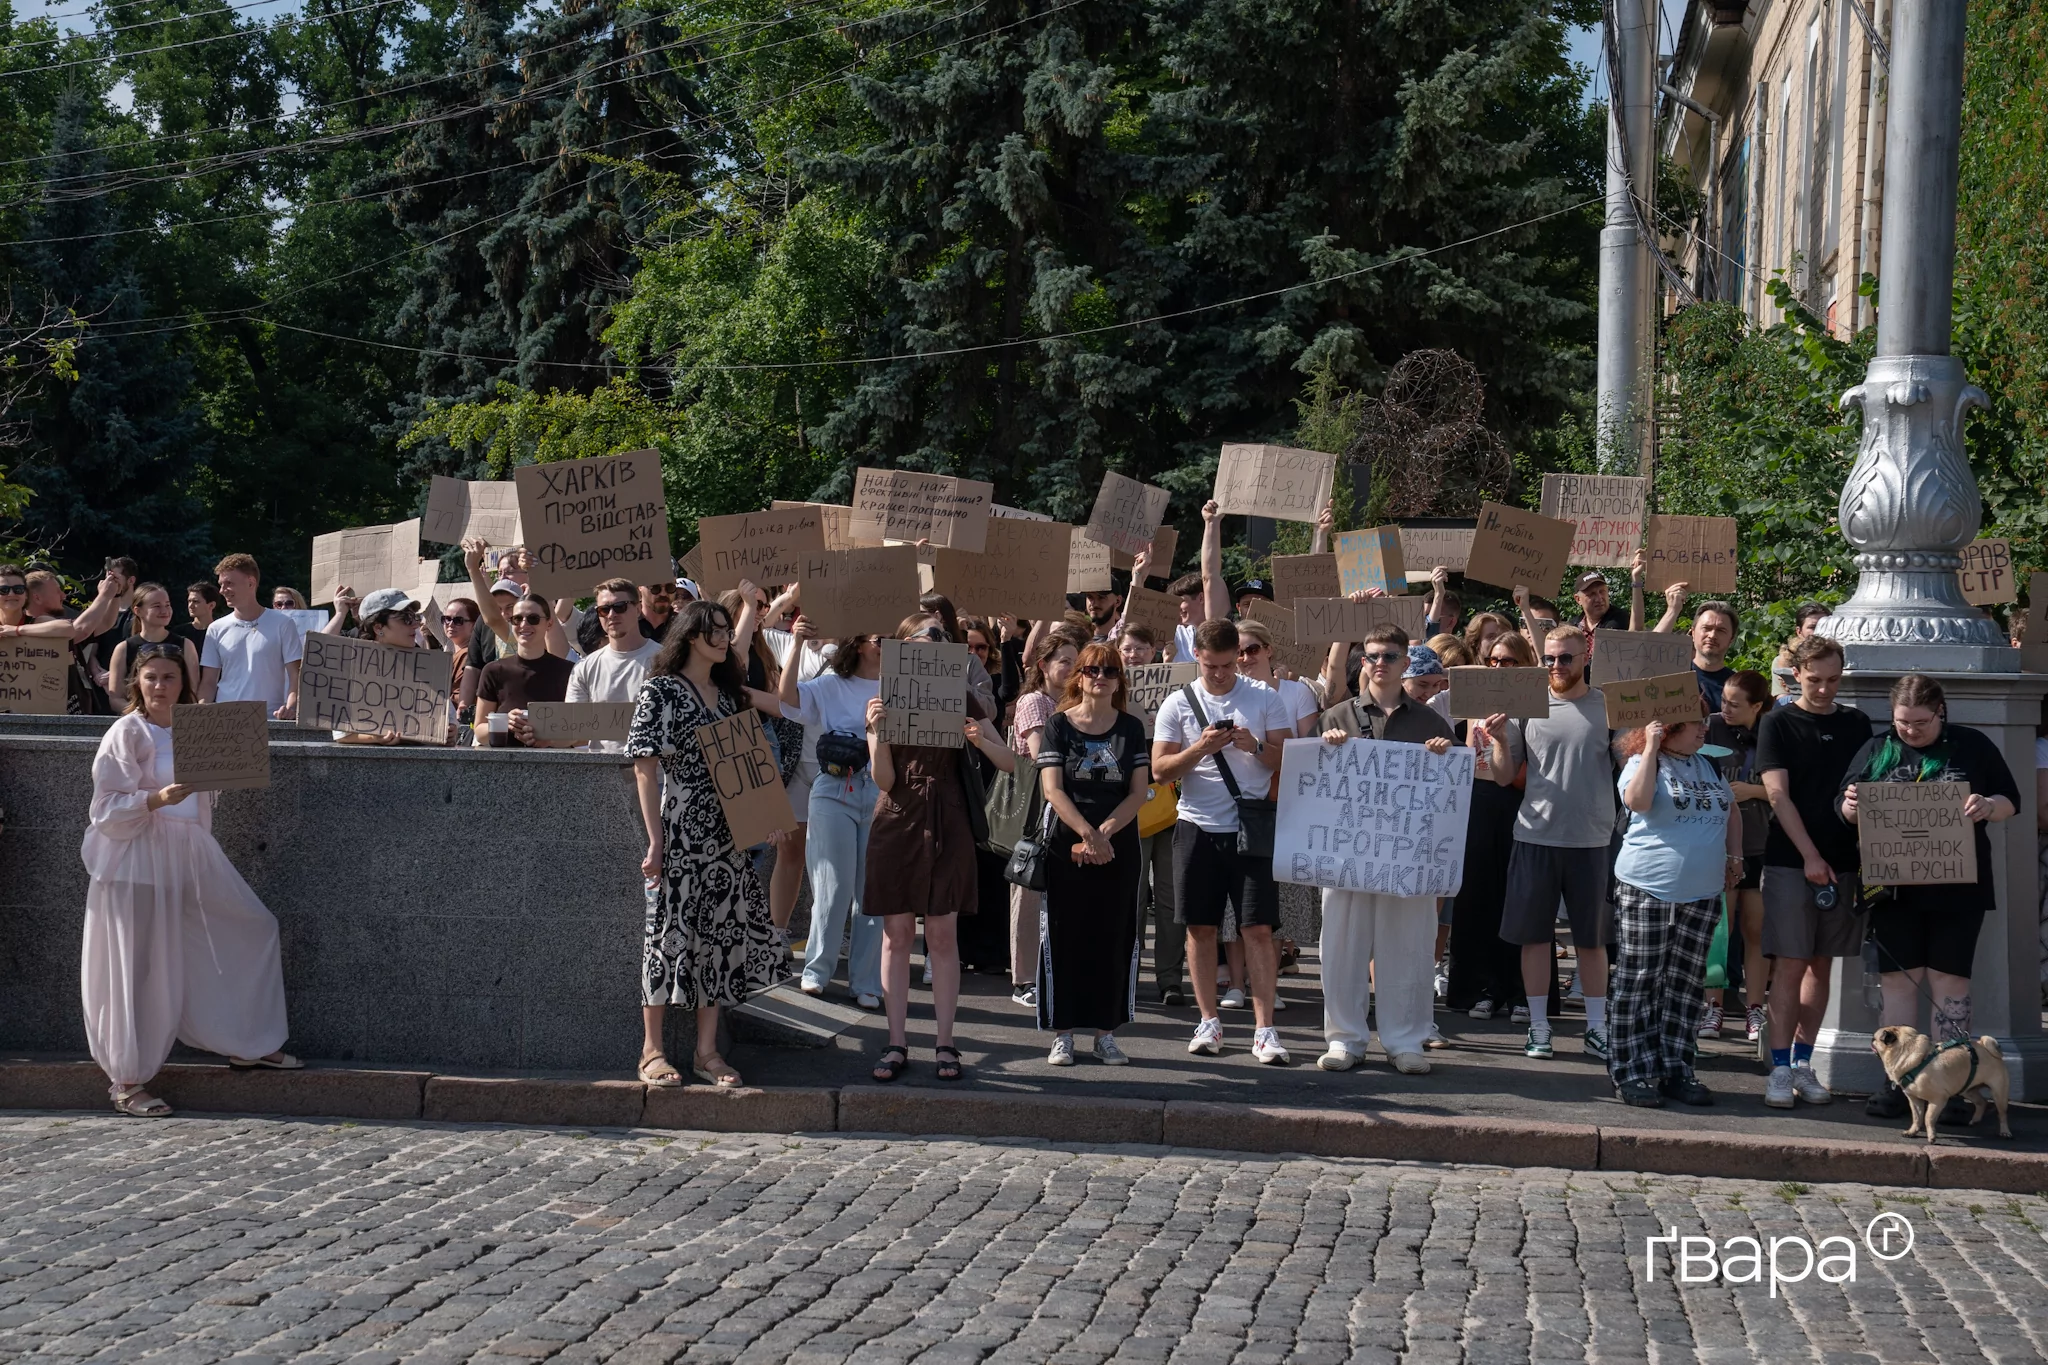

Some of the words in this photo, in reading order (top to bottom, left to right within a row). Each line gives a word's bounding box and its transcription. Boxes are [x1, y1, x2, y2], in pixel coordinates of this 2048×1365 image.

[536, 460, 636, 500] ХАРКІВ
[1115, 479, 1160, 509] РУКИ
[1557, 477, 1644, 498] ЗВІЛЬНЕННЯ
[1113, 498, 1145, 520] ГЕТЬ
[1557, 497, 1641, 515] ФЕДОРОВА
[1127, 521, 1157, 540] НАБУ
[1484, 511, 1502, 532] Не
[1500, 523, 1534, 541] робіть
[1559, 518, 1642, 536] ОДАРУНОК
[1500, 540, 1544, 565] послугу
[1305, 603, 1345, 636] МИ
[15, 641, 60, 658] РІШЕНЬ
[899, 642, 962, 678] Effective
[1600, 639, 1688, 667] ФЕДОРОВ
[302, 671, 447, 718] ФЕДОРОВА
[1616, 709, 1647, 722] МОЖЕ
[1651, 694, 1700, 718] ДОСИТЬ?
[536, 706, 600, 734] Федоров
[907, 712, 965, 748] Fedorov
[697, 709, 767, 765] НЕМА
[714, 748, 776, 800] СЛІВ
[1317, 743, 1472, 786] МАЛЕНЬКА
[1297, 771, 1457, 814] РАДЯНСЬКА
[1869, 784, 1963, 803] ВІДСТАВКА
[1335, 801, 1435, 836] АРМІЯ
[1866, 807, 1964, 829] ФЕДОРОВА
[1307, 824, 1455, 868] ПРОГРАЄ
[1870, 840, 1964, 858] ПОДАРУНОК
[1291, 852, 1458, 897] ВЕЛИКІЙ!
[1867, 862, 1900, 881] ДЛЯ
[1911, 859, 1964, 880] РУСНІ
